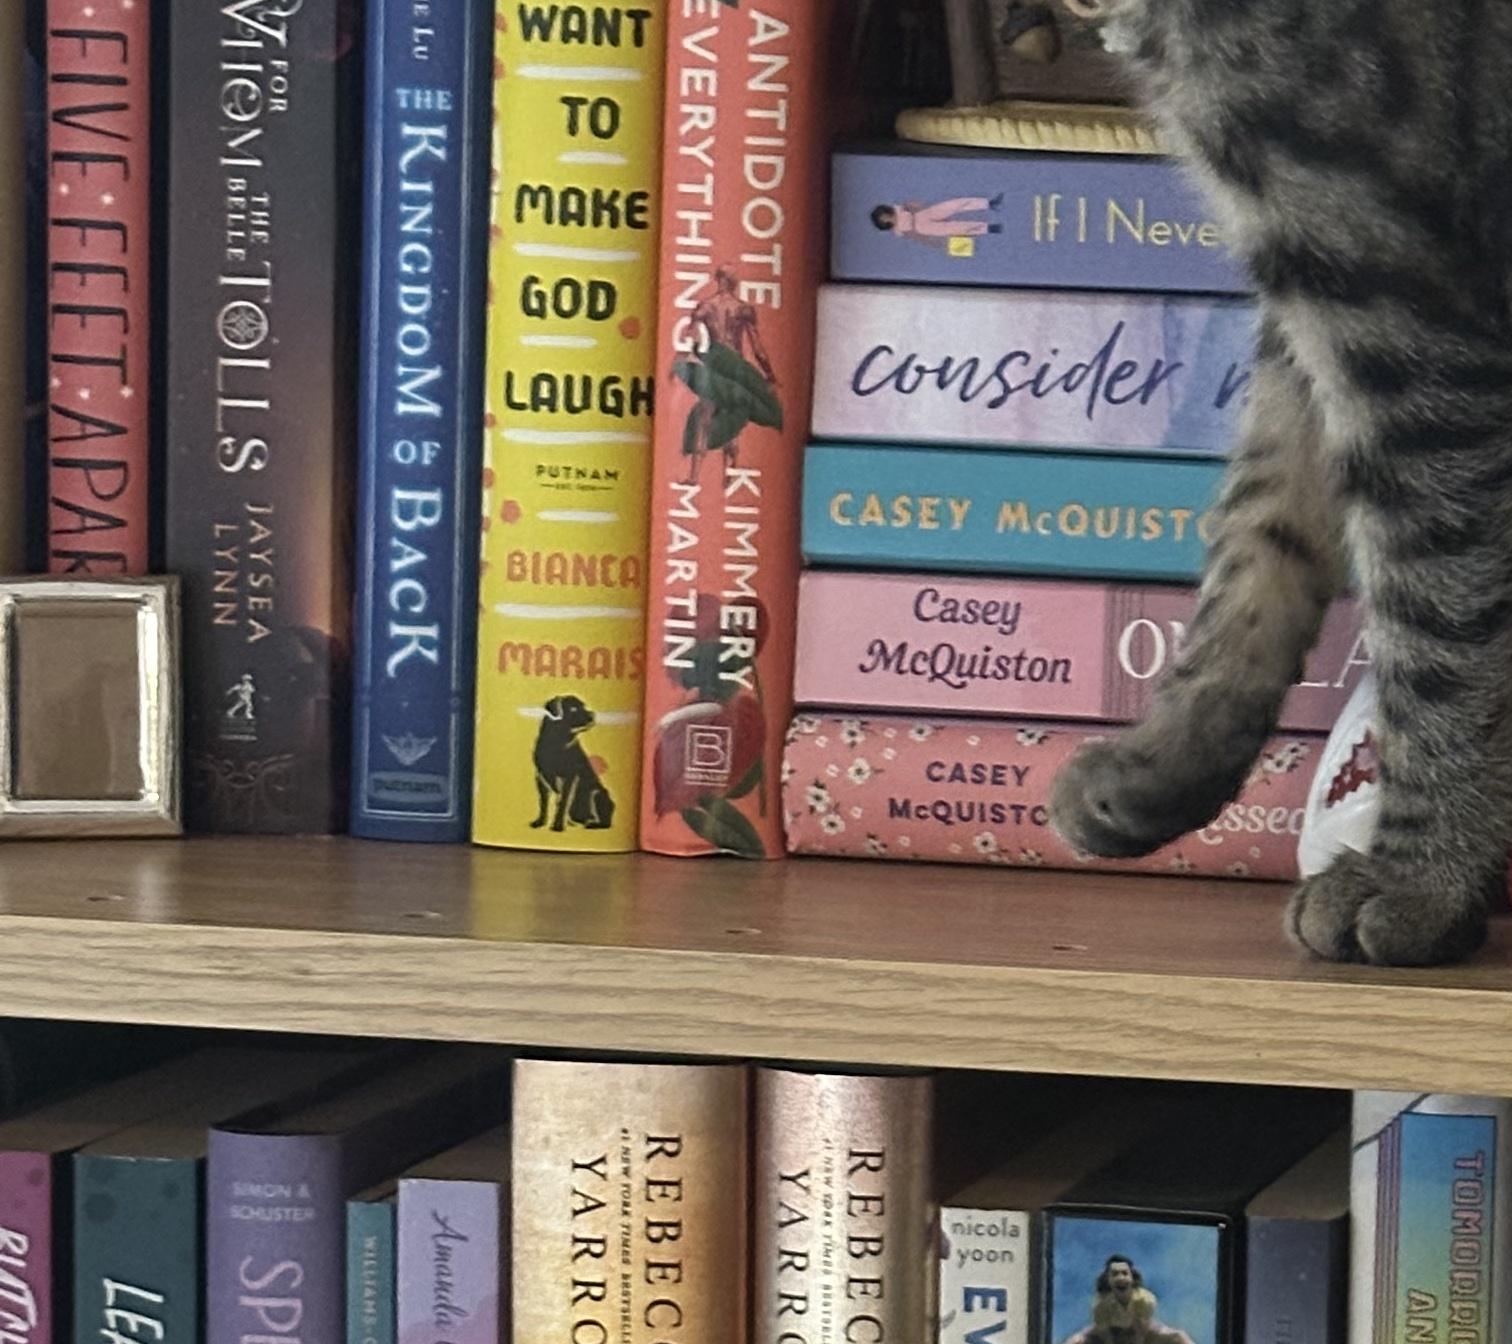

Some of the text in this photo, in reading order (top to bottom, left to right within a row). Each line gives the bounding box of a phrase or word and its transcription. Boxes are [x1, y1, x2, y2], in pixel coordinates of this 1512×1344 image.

[517, 3, 654, 49] WANT
[49, 27, 131, 182] FIVE
[395, 87, 453, 112] THE
[559, 95, 622, 139] TO
[738, 9, 790, 309] ANTIDOTE
[513, 184, 651, 229] MAKE
[394, 122, 448, 419] KINGDOM
[49, 217, 130, 386] FEET
[520, 275, 618, 321] GOD
[504, 370, 656, 417] LAUGH
[851, 319, 1178, 421] consider
[393, 440, 442, 466] OF
[535, 463, 620, 482] PUTNAM
[212, 524, 239, 626] LYNN
[245, 502, 276, 645] JAYSEA
[386, 486, 443, 678] BACK
[505, 549, 641, 589] BIANCA
[663, 481, 702, 670] MARTIN
[717, 467, 762, 691] KIMMERY
[912, 587, 1021, 635] Casey
[497, 641, 647, 679] MARAIS
[859, 636, 1073, 688] McQuiston
[951, 1216, 1021, 1239] nicola
[956, 1244, 1015, 1266] yoon
